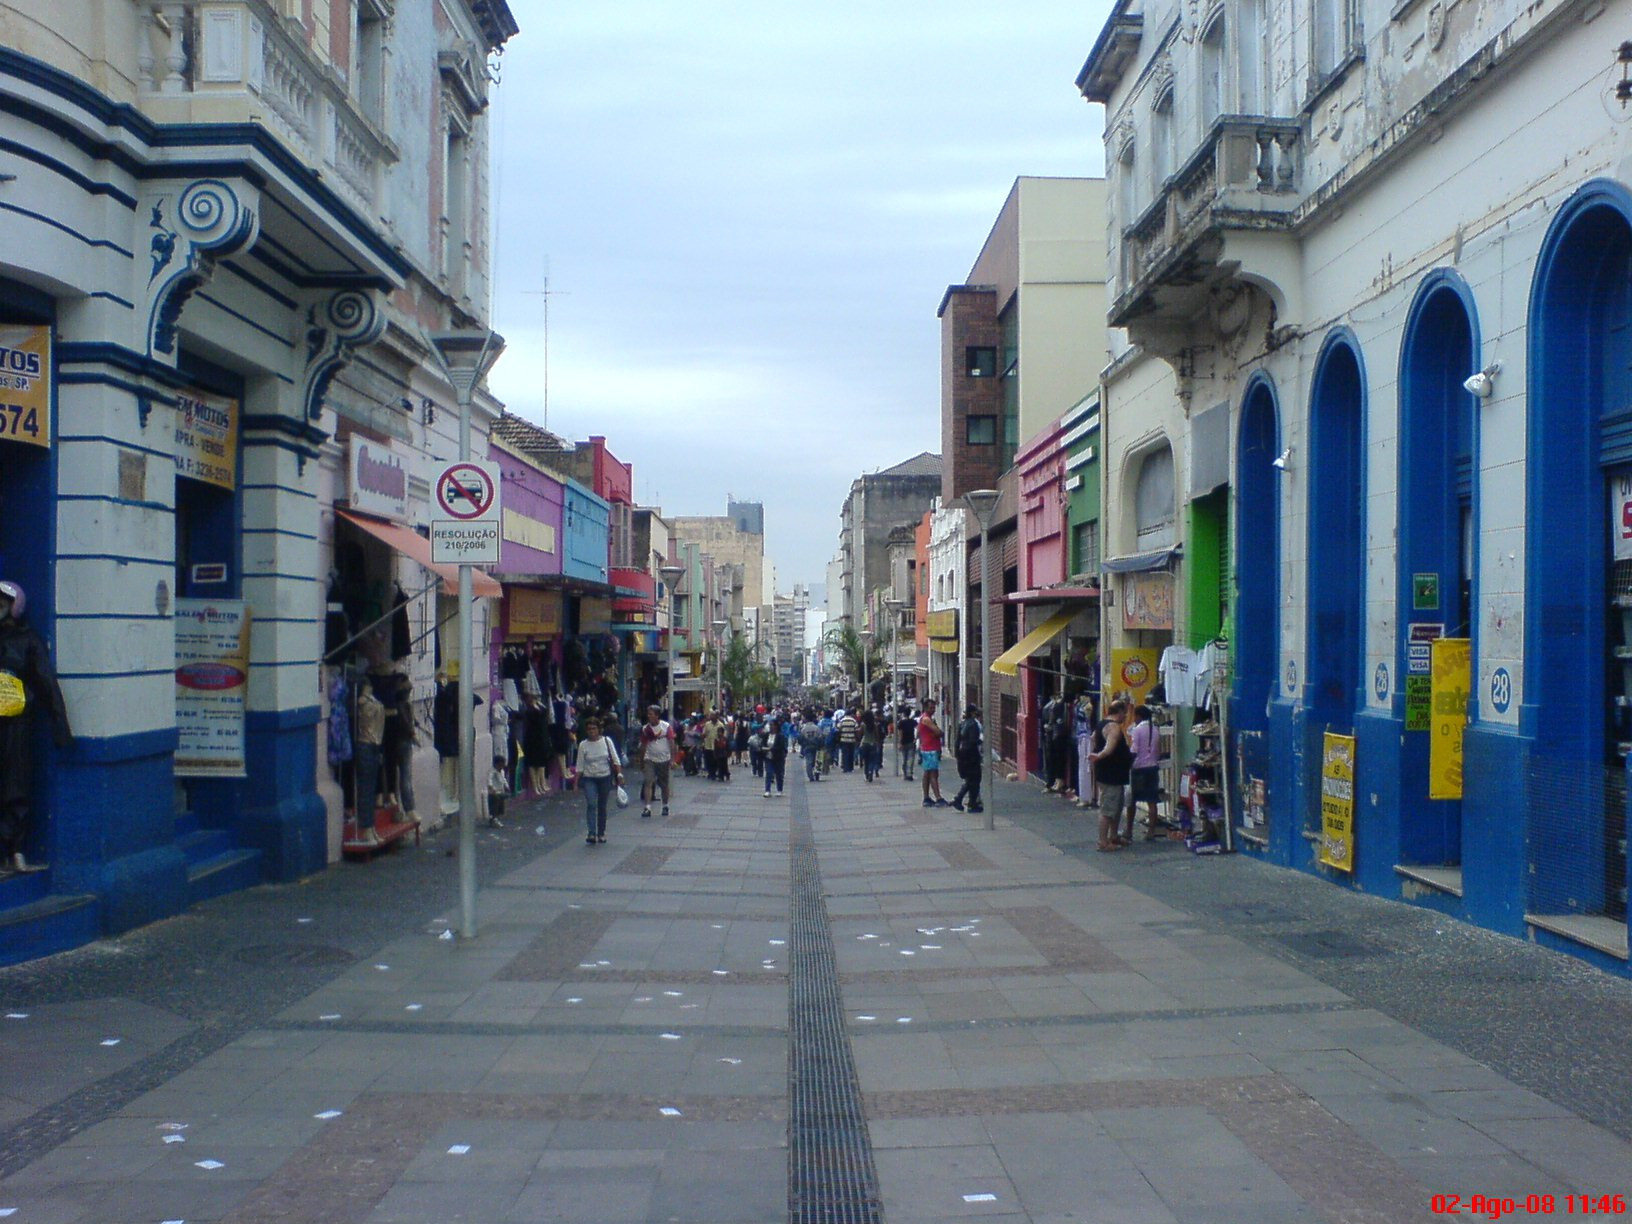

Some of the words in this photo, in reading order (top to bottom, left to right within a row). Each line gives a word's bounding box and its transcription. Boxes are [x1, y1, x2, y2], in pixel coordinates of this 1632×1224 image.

[434, 529, 497, 540] RESOLUÇÃO
[445, 541, 486, 550] 210/2006
[1411, 648, 1428, 656] VISA
[1411, 661, 1428, 669] VISA
[1376, 669, 1388, 692] 28
[1492, 673, 1508, 705] 28
